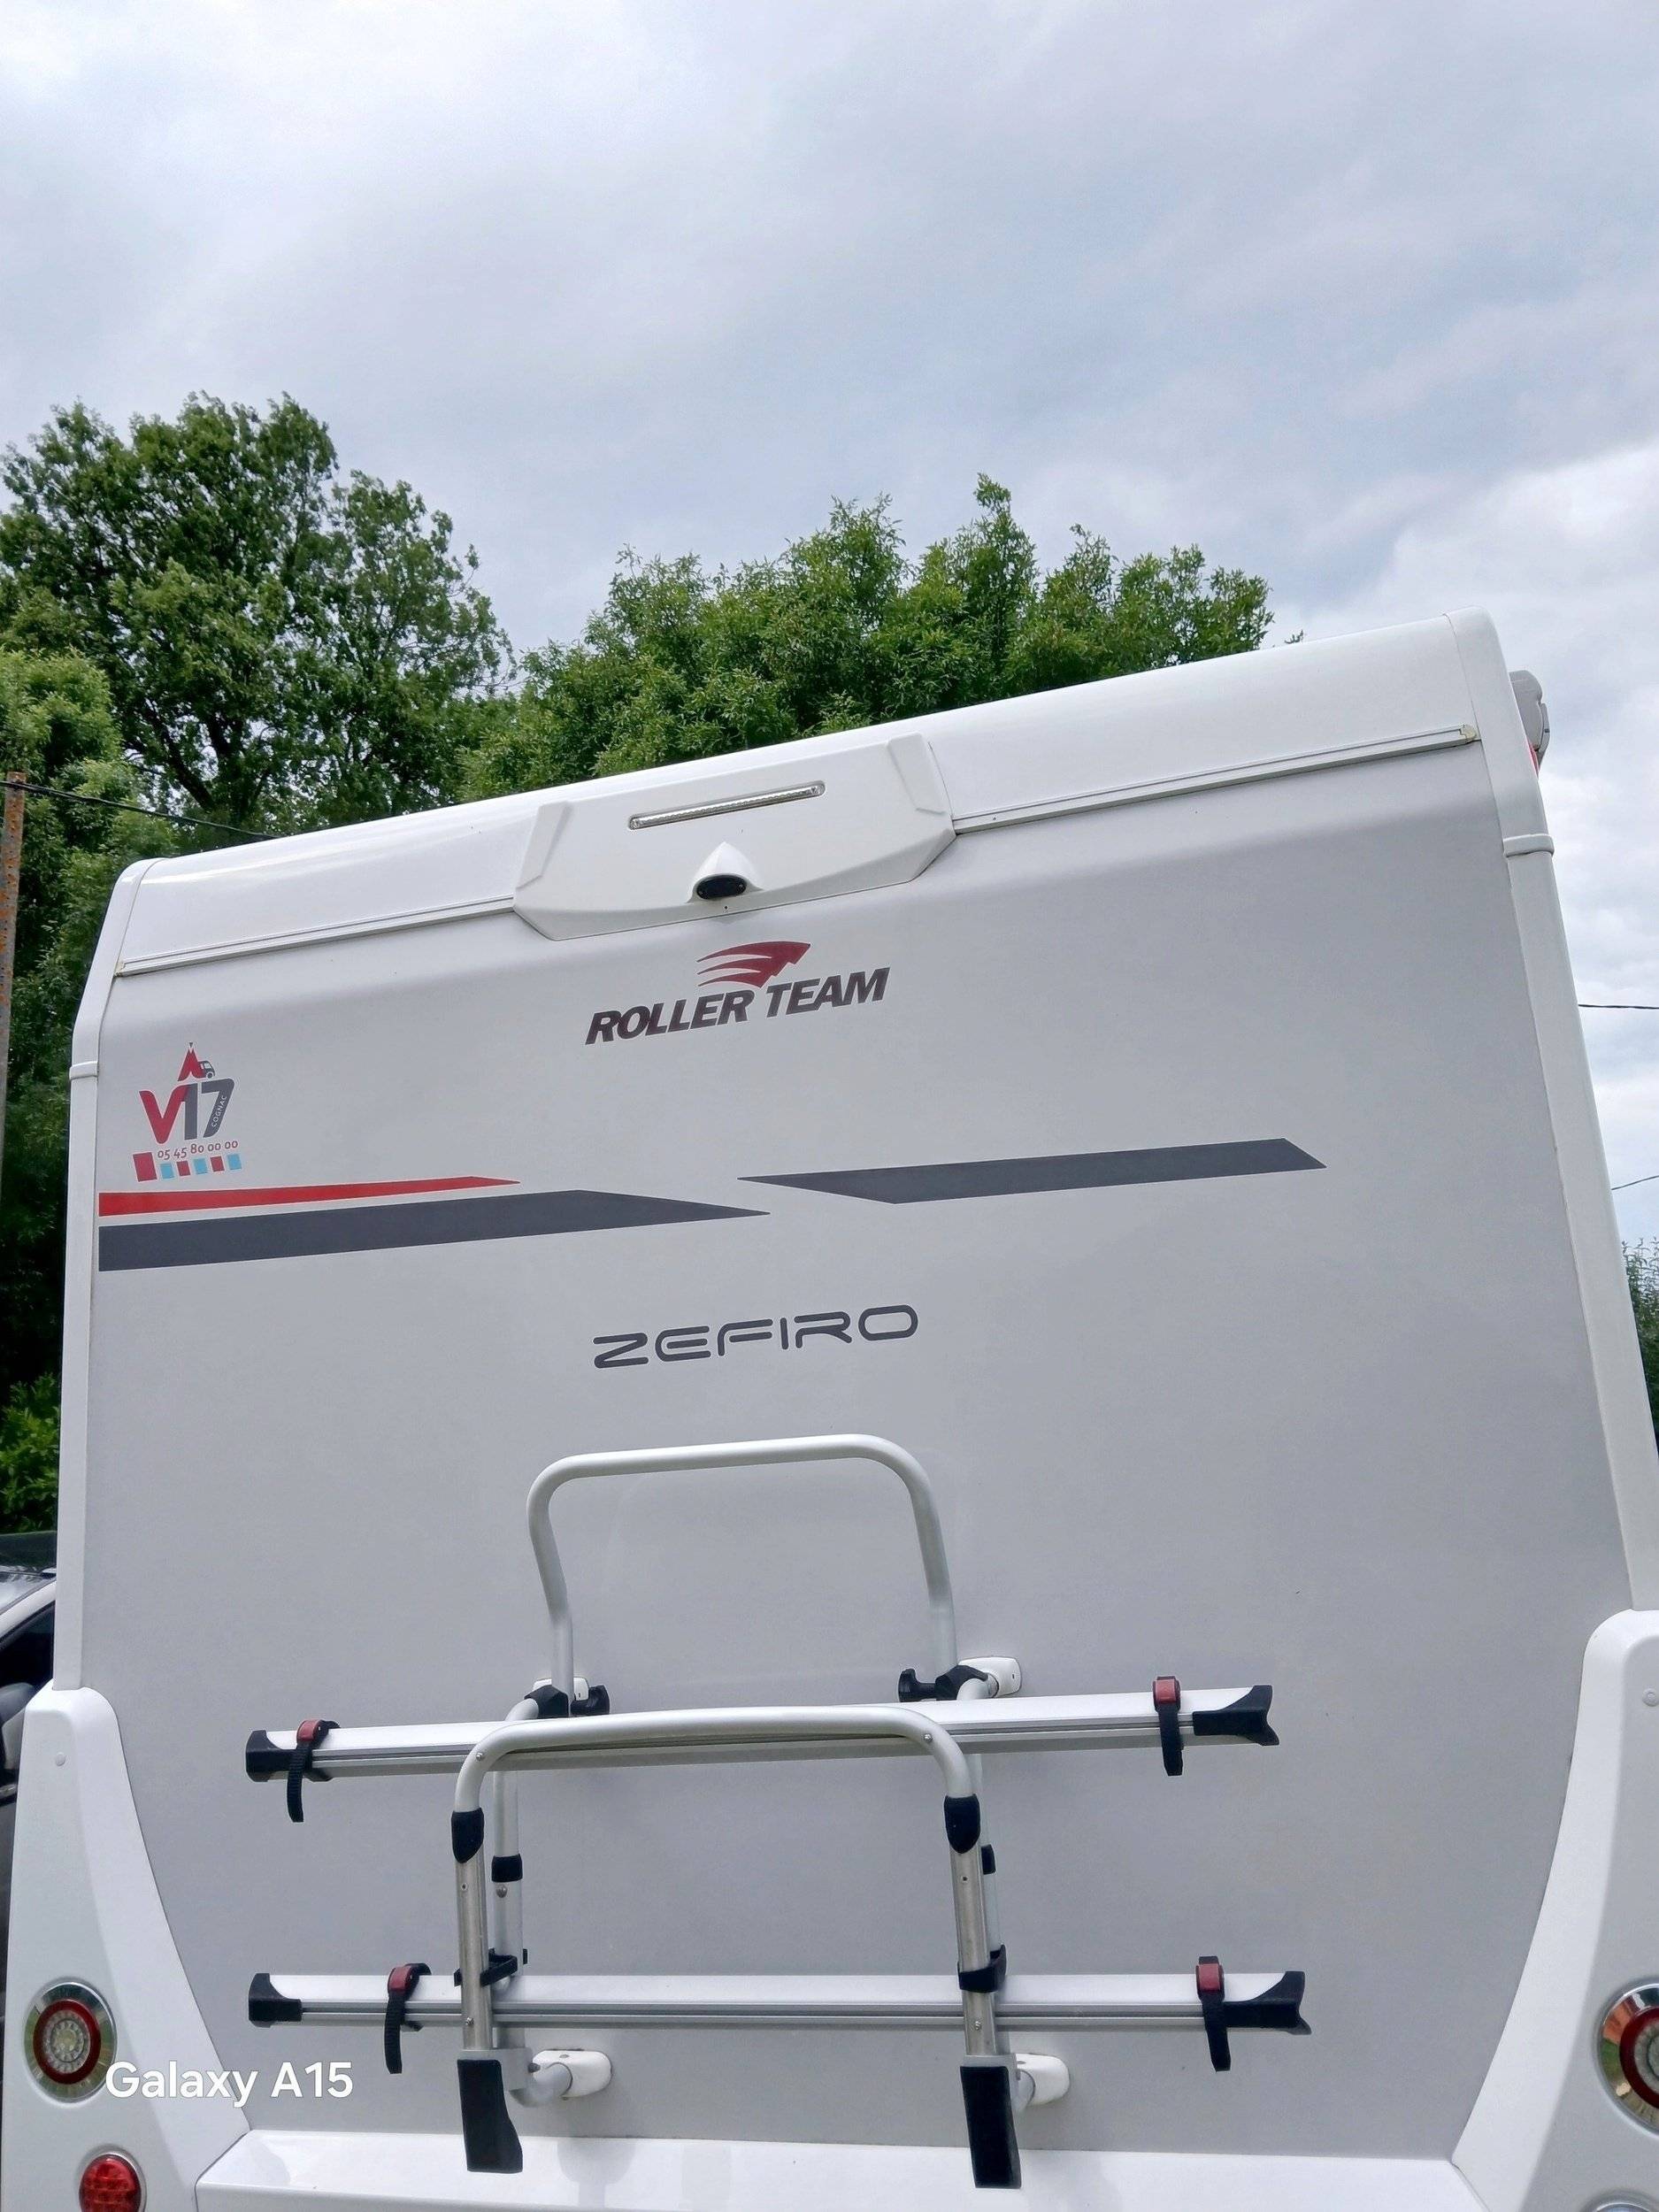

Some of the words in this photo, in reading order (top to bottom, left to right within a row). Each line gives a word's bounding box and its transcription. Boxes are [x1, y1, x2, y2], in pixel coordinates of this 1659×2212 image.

[584, 988, 756, 1046] ROLLER
[765, 966, 891, 1018] TEAM
[139, 1078, 235, 1144] V17
[211, 1094, 227, 1128] COGNAC
[157, 1149, 170, 1160] 05
[173, 1147, 188, 1159] 45
[190, 1143, 204, 1154] 80
[207, 1142, 221, 1152] 00
[224, 1140, 239, 1149] 00
[593, 1304, 919, 1369] ZEFIRO
